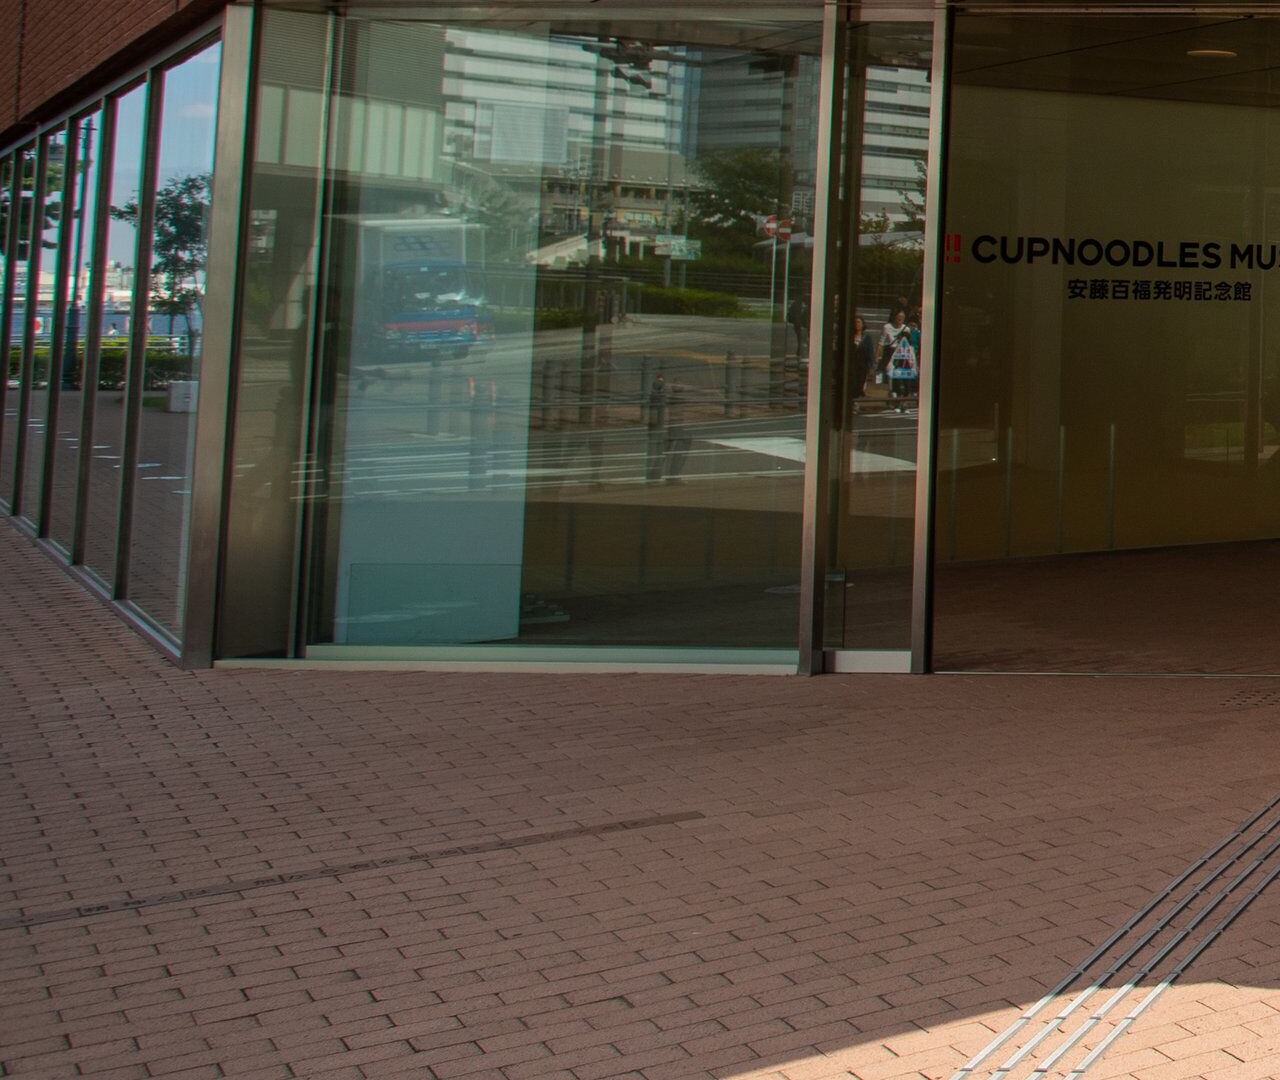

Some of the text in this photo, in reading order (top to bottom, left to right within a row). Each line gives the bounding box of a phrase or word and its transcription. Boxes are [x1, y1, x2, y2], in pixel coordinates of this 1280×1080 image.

[971, 235, 1222, 269] CUPNOODLES
[1067, 279, 1252, 302] 安藤百福発明記念館
